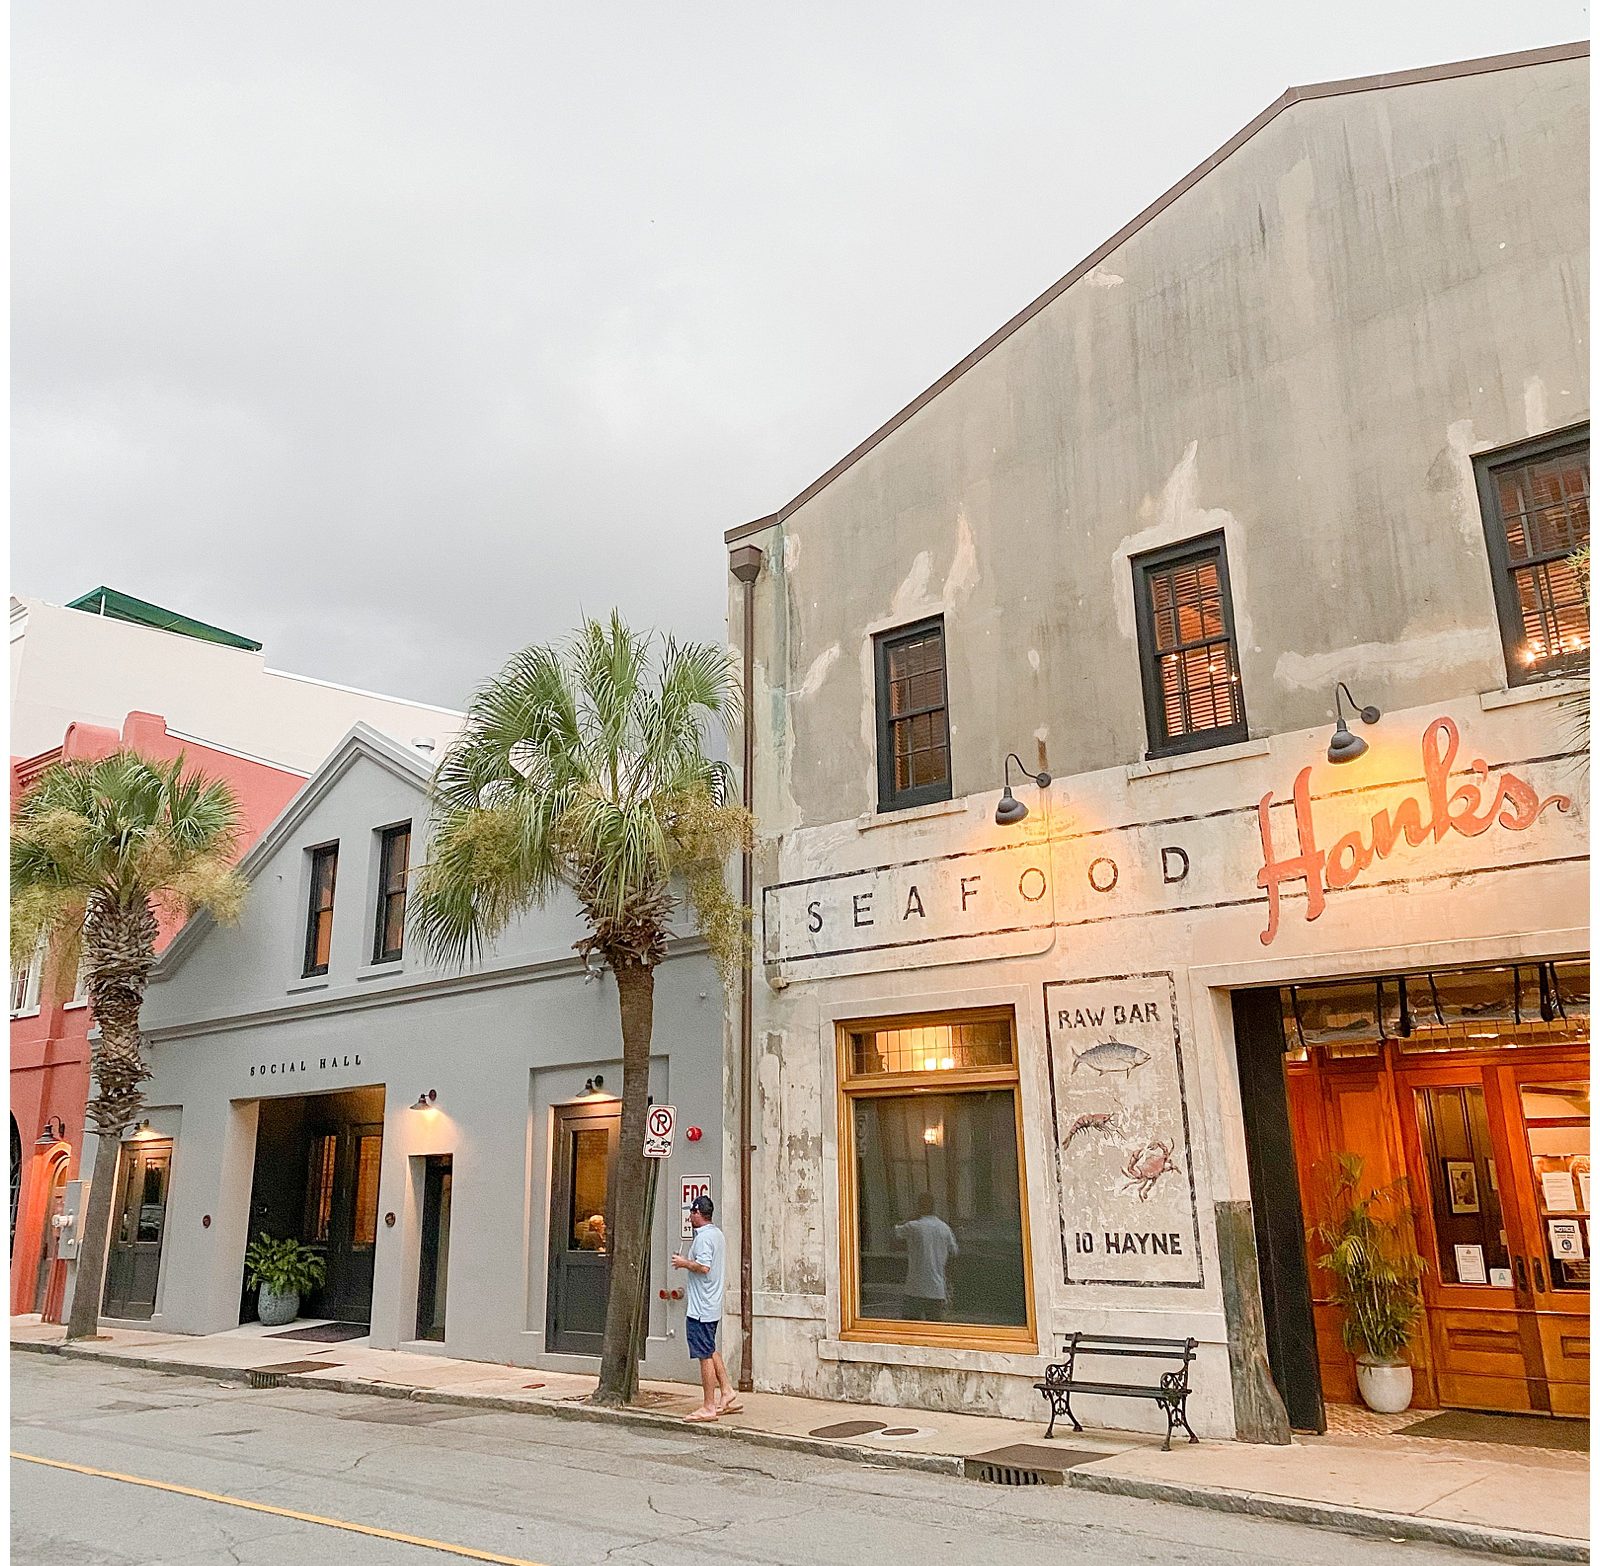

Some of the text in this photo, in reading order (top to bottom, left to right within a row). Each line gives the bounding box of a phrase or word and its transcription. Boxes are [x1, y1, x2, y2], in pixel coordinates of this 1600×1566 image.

[1257, 716, 1571, 946] Hank's
[806, 846, 1190, 934] SEAFOOD
[1058, 1002, 1160, 1030] RAW BAR
[250, 1055, 361, 1076] SOCIAL HALL
[1075, 1232, 1182, 1256] 10 HAYNE
